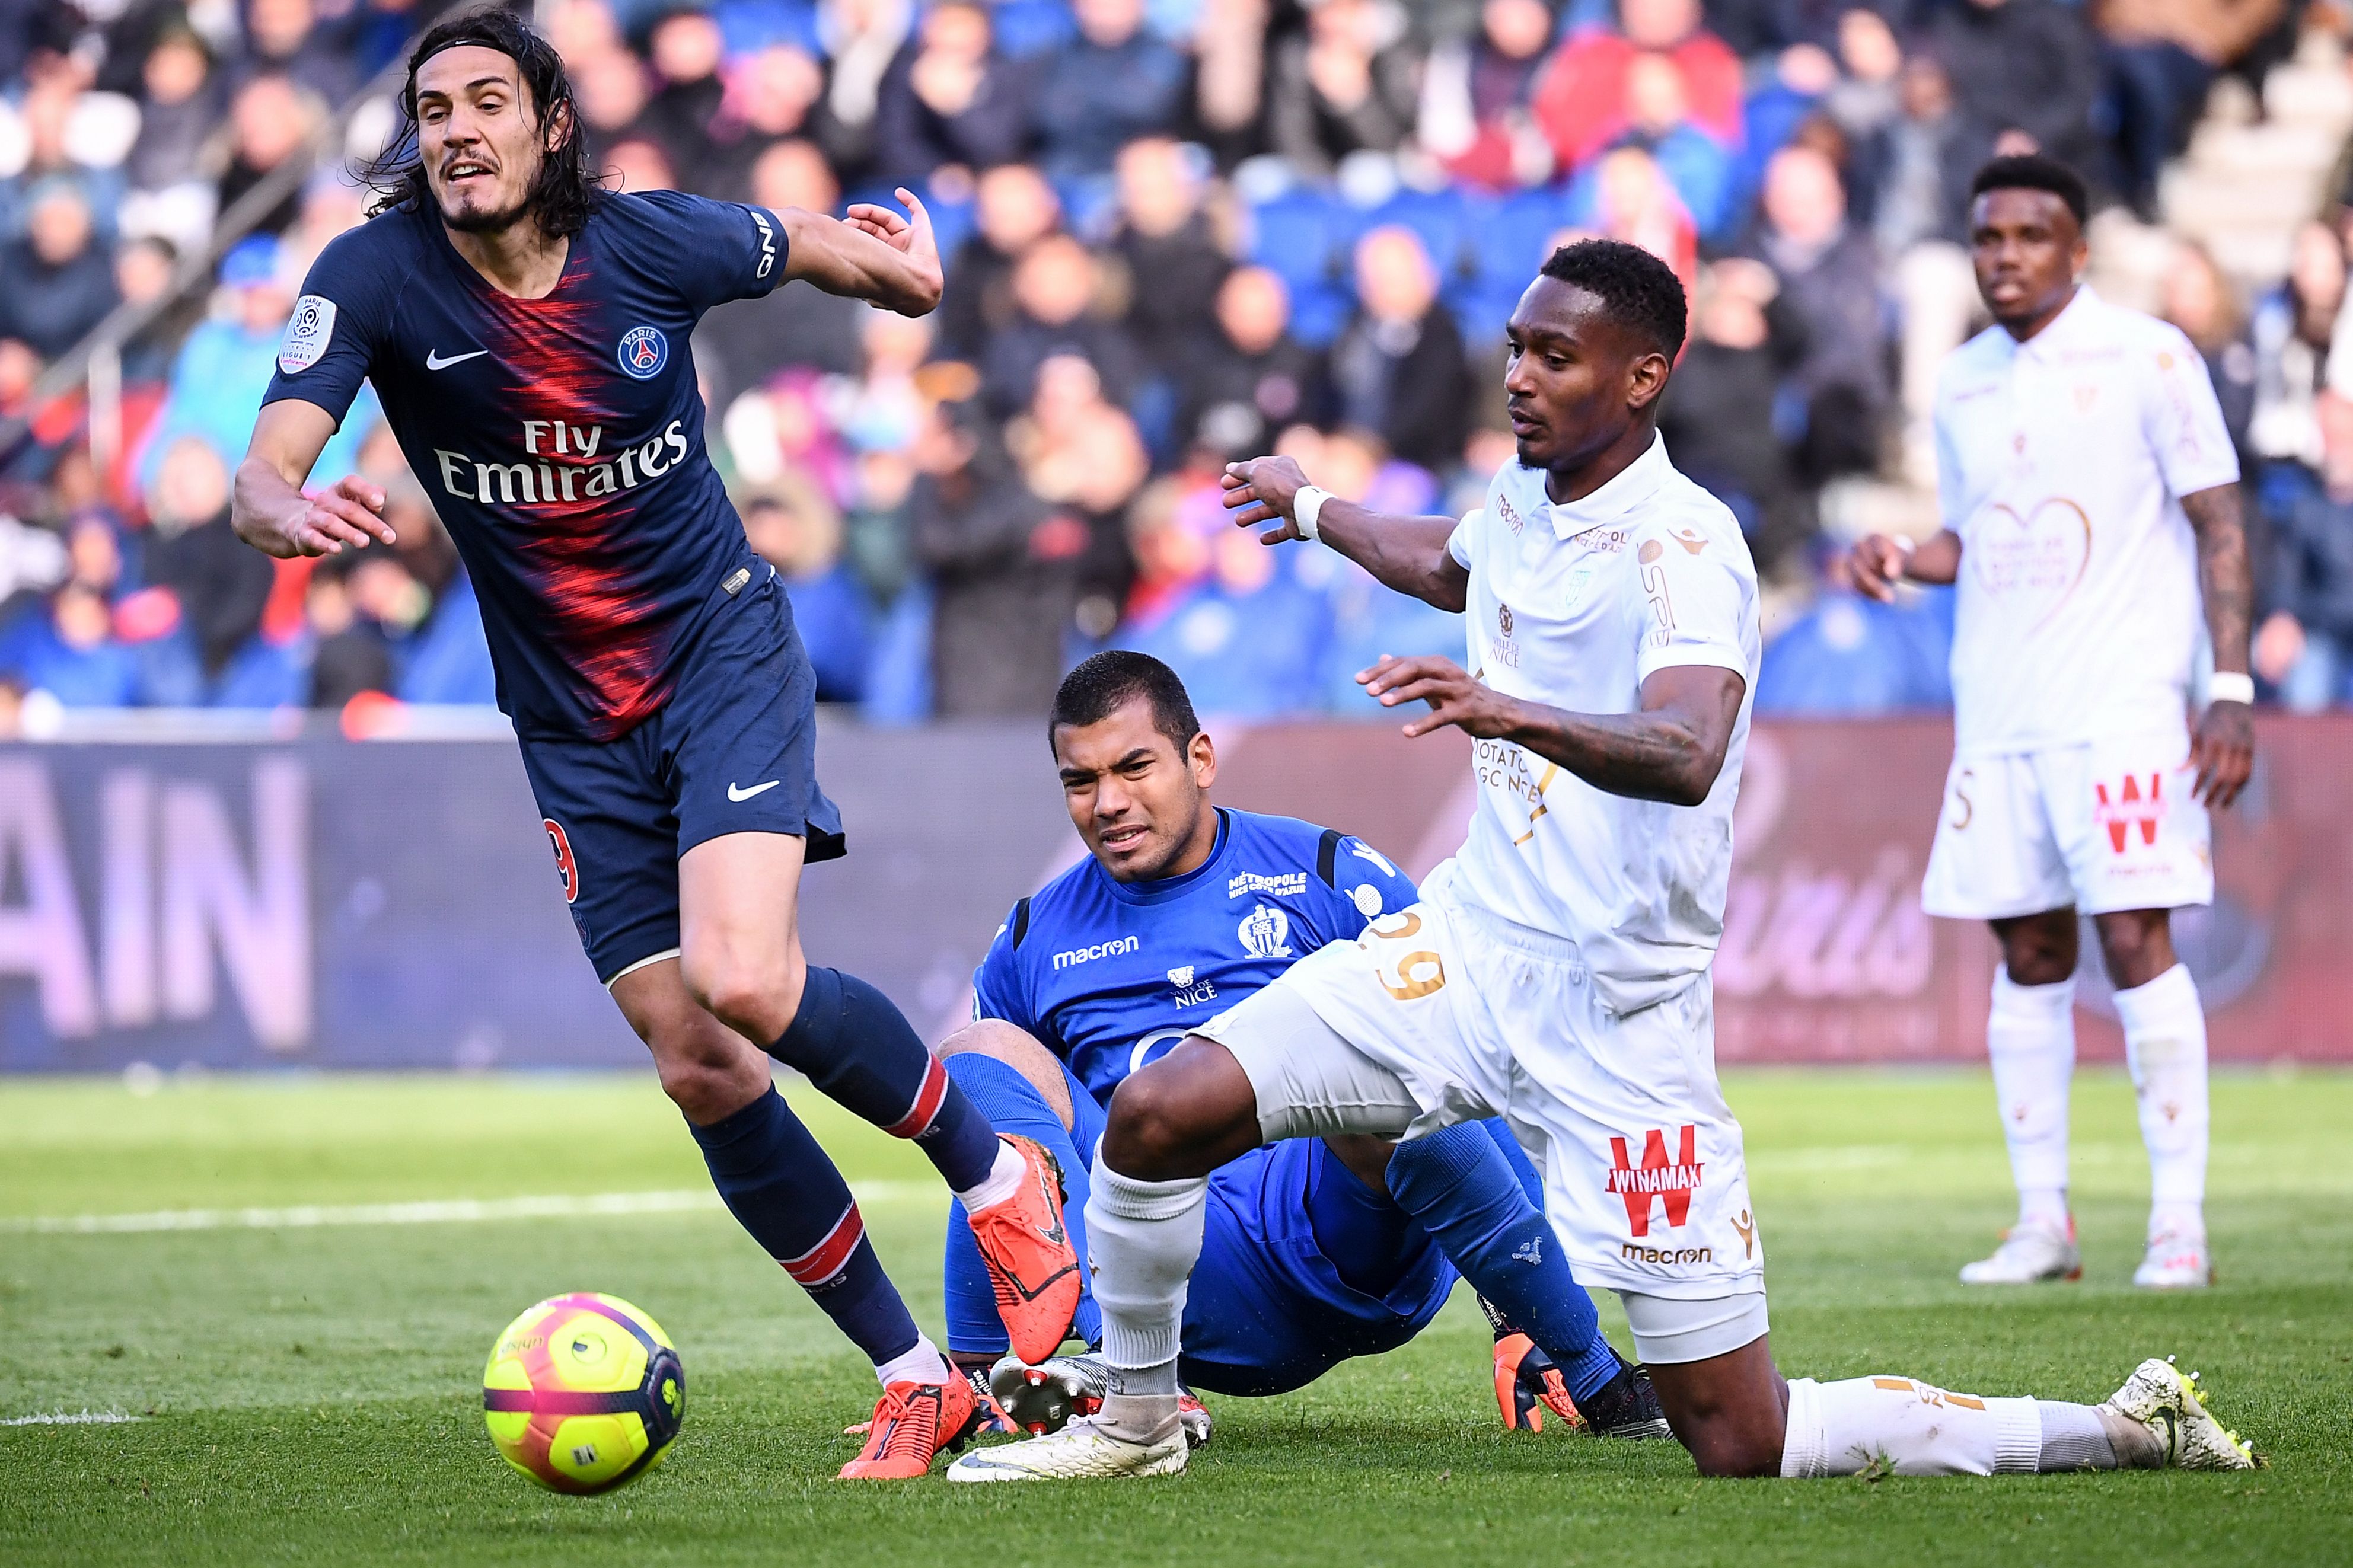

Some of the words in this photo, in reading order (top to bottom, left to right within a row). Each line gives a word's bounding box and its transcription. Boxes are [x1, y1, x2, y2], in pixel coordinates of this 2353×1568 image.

[751, 212, 775, 279] QNB
[305, 298, 322, 307] PARIS
[624, 329, 656, 346] PARIS
[523, 420, 601, 458] Fly
[433, 420, 687, 504] Emirates
[543, 818, 578, 904] 9
[1228, 871, 1307, 890] MÉTROPOLE
[1229, 885, 1248, 899] NICE
[1274, 885, 1306, 896] D'AZUR
[1053, 935, 1139, 970] macron
[1174, 985, 1217, 1010] NICE
[1613, 1163, 1701, 1193] WINAMAX
[1622, 1243, 1711, 1264] macron
[973, 1369, 994, 1397] enitez
